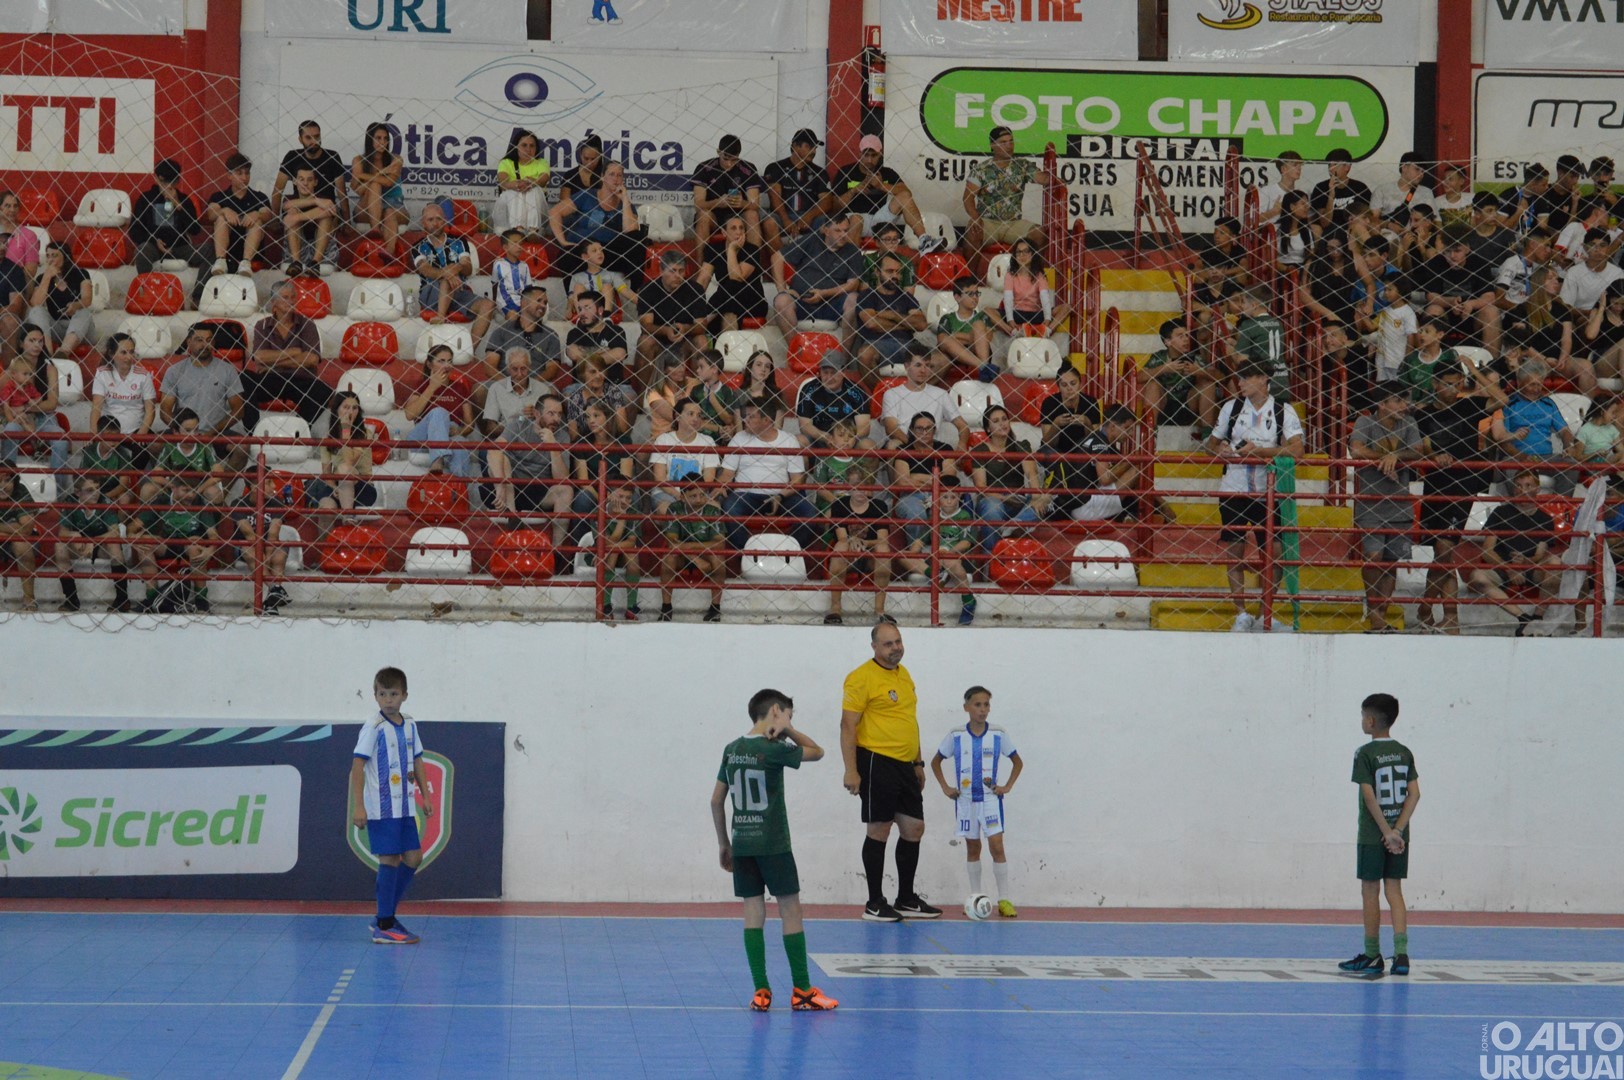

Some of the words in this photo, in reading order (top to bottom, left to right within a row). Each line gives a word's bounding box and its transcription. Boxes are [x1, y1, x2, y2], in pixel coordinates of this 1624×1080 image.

[1269, 11, 1320, 21] Restaurante
[955, 93, 1121, 133] FOTO
[1148, 97, 1360, 137] CHAPA
[407, 171, 460, 184] ÓCULOS
[421, 187, 440, 196] 829
[450, 188, 484, 197] Centro
[660, 193, 680, 202] (55)
[1069, 193, 1115, 217] SUA
[54, 794, 268, 848] Sicredi
